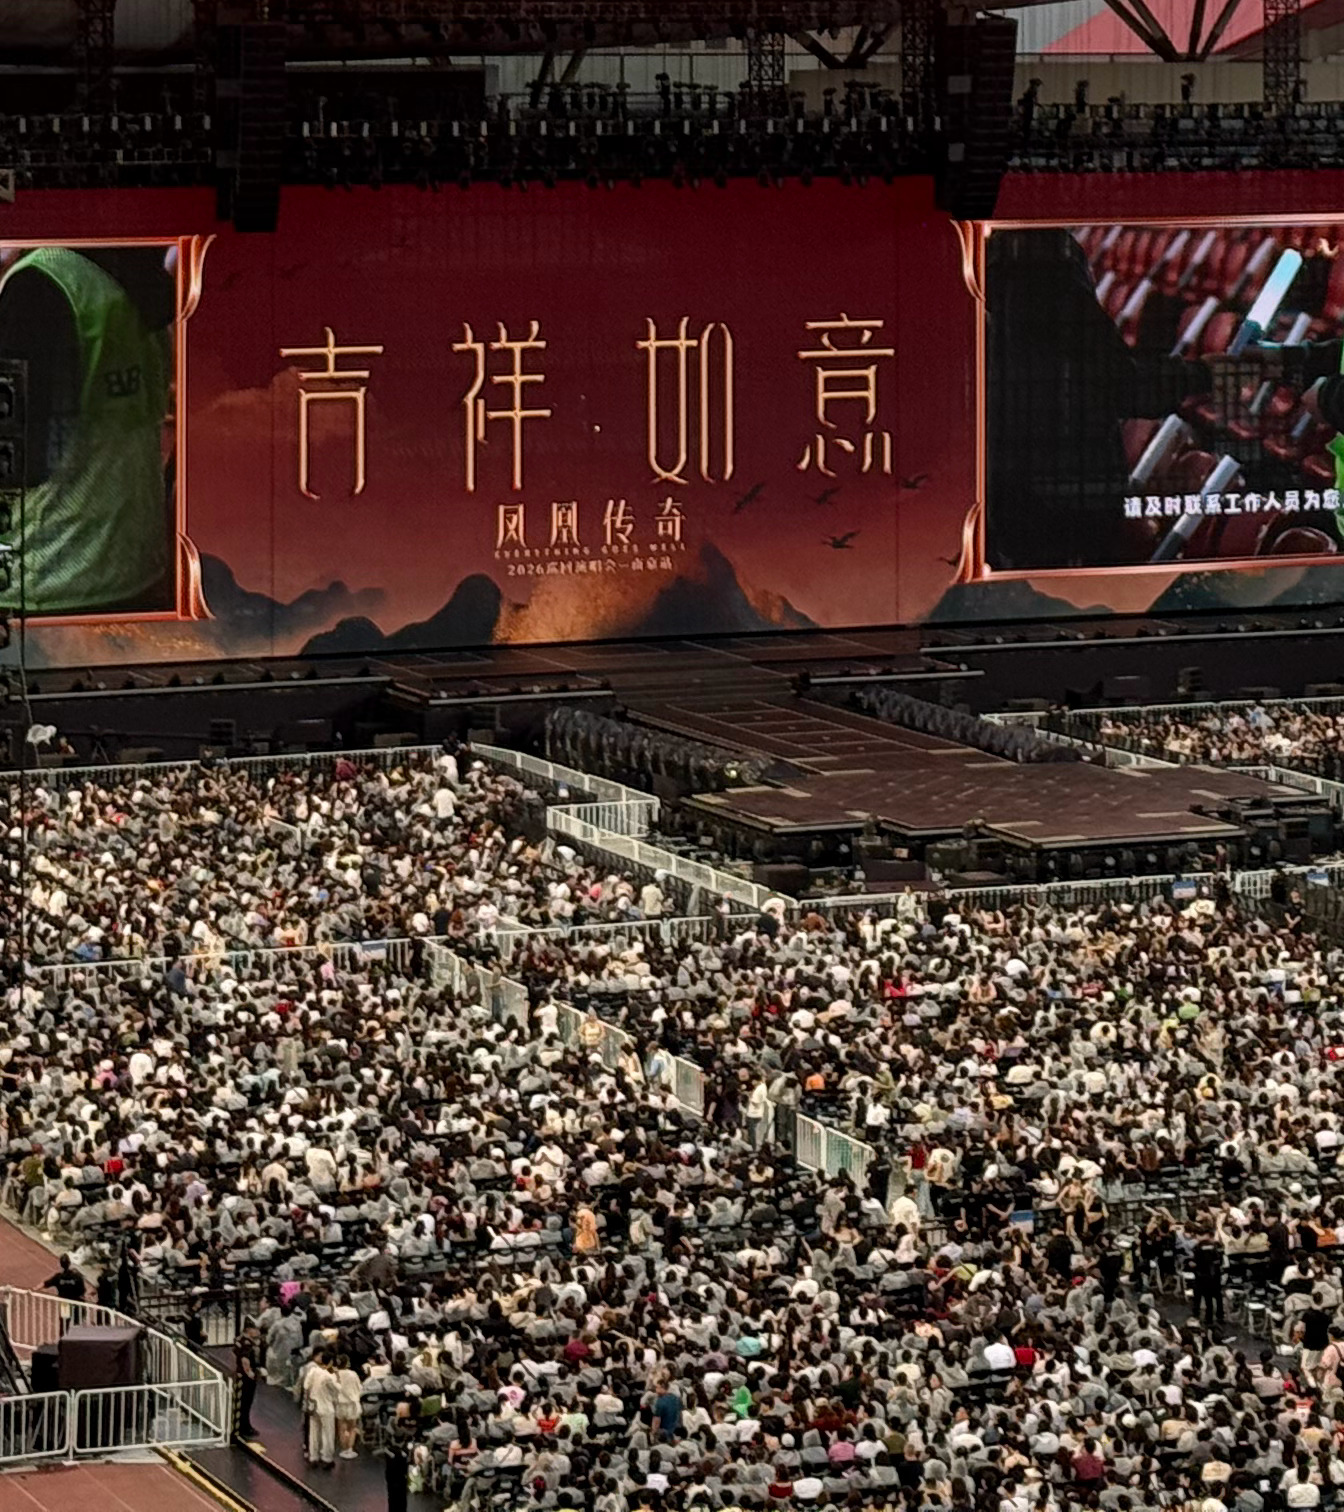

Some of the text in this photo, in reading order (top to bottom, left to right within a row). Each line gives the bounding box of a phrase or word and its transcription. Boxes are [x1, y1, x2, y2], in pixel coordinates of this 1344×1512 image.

[278, 311, 896, 500] 吉祥如意
[496, 496, 687, 549] 凤凰传奇
